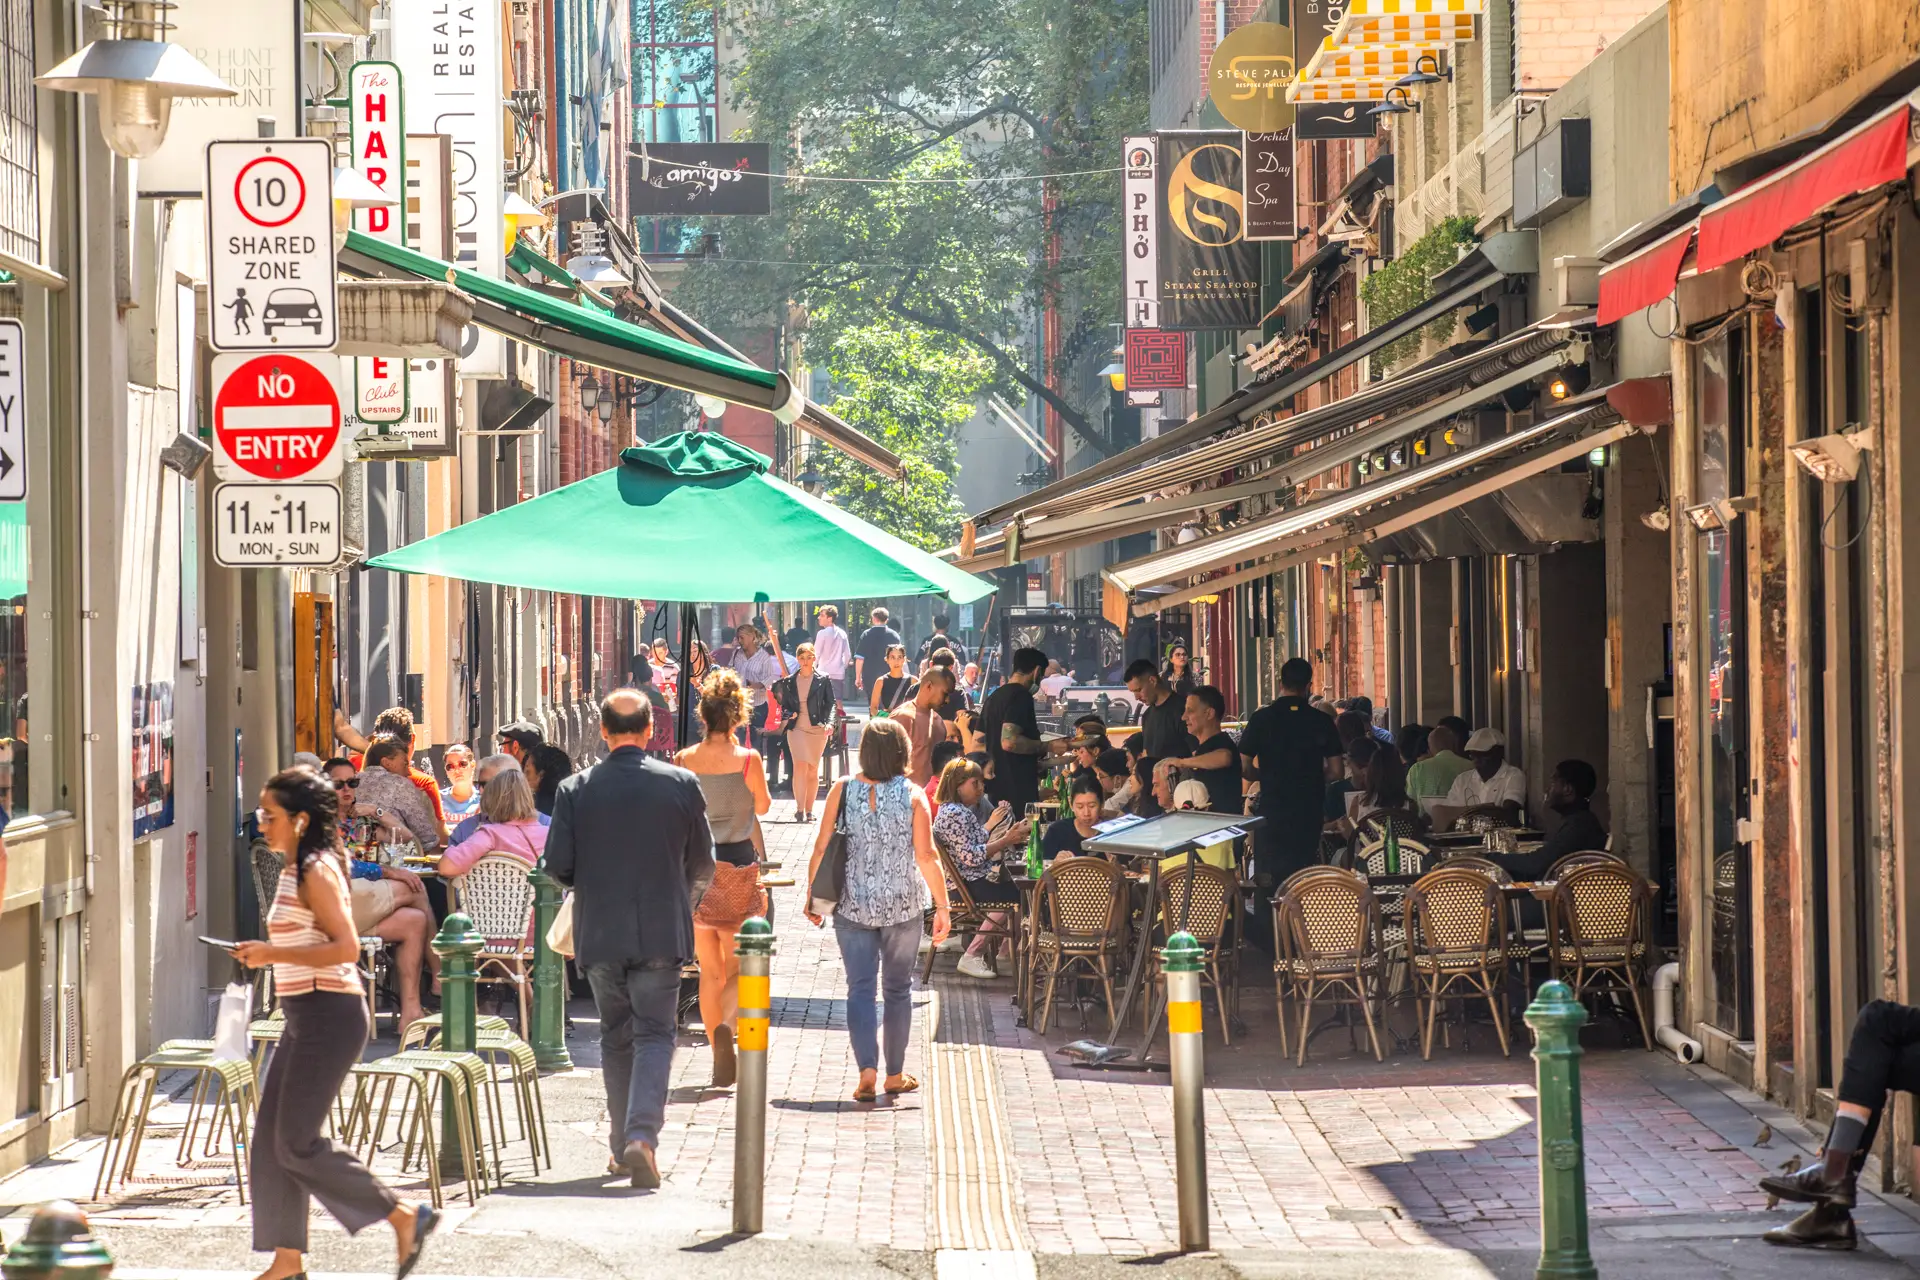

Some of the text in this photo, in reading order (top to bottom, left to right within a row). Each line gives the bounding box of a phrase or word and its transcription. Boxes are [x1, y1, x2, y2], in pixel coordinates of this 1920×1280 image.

[432, 3, 449, 76] REAL
[458, 0, 475, 76] ESTA
[217, 47, 276, 67] HUNT
[217, 67, 276, 88] HUNT
[361, 72, 389, 89] The
[1217, 69, 1257, 79] STEVE
[1255, 151, 1292, 178] Day
[666, 161, 743, 193] amigos
[253, 177, 287, 208] 10
[1247, 182, 1279, 210] Spa
[228, 235, 316, 255] SHARED
[244, 261, 302, 280] ZONE
[1192, 267, 1229, 278] GRILL
[1164, 280, 1258, 291] STEAK SEAFOOD
[1175, 292, 1248, 300] RESTAURANT
[257, 373, 296, 399] NO
[365, 382, 399, 403] Club
[361, 406, 402, 414] UPSTAIRS
[235, 434, 325, 460] ENTRY
[239, 542, 274, 556] MON
[288, 541, 320, 556] SUN
